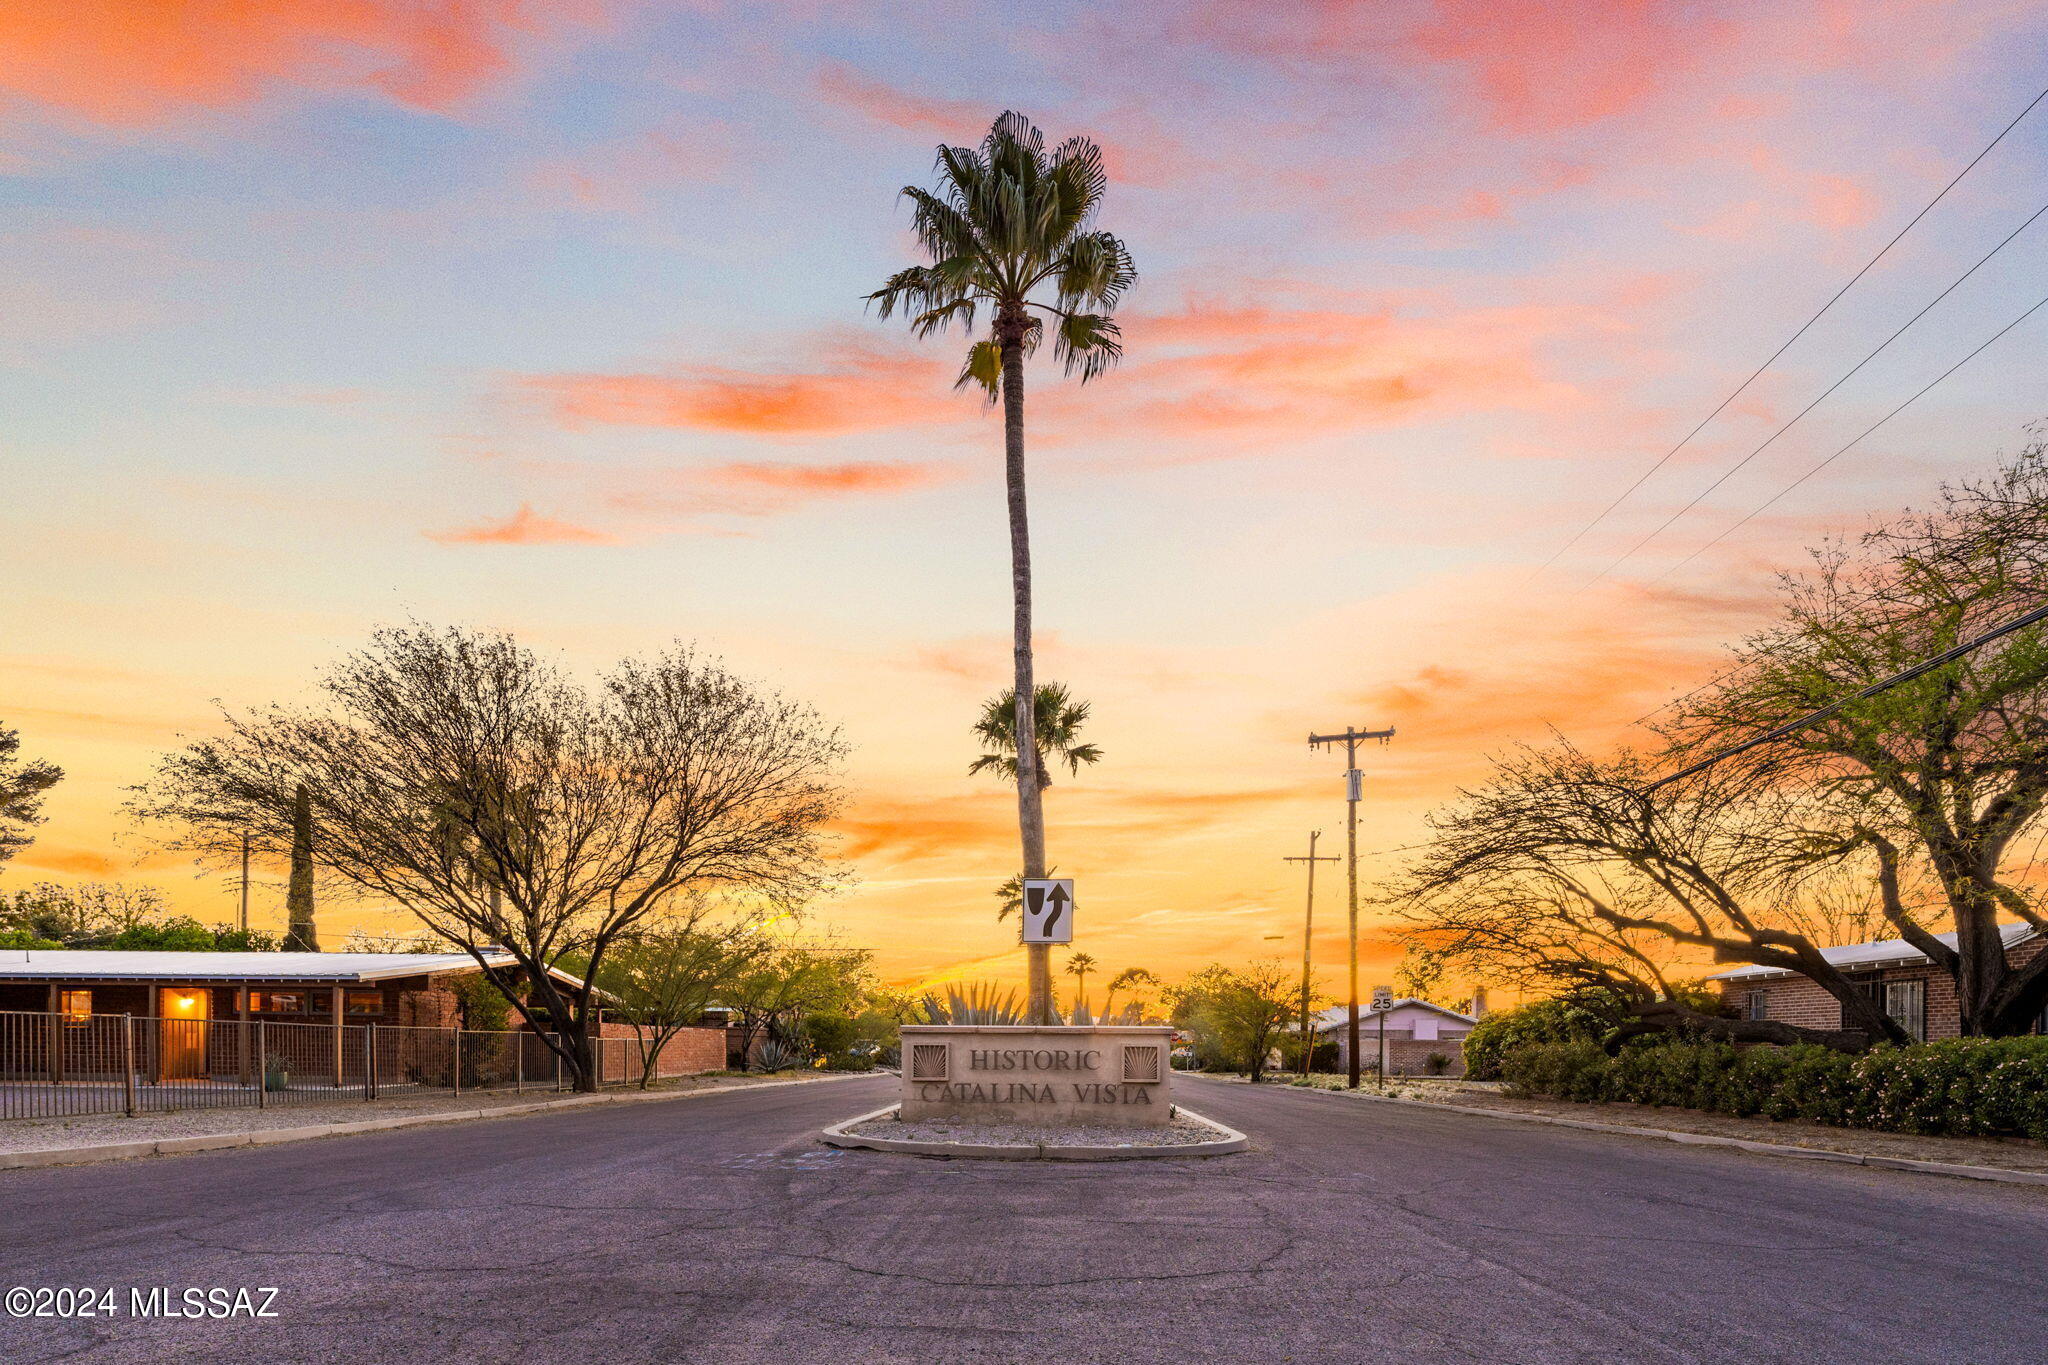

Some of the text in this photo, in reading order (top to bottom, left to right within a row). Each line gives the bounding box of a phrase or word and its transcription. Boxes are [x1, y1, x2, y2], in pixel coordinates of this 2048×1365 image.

[1373, 998, 1391, 1009] 25
[969, 1049, 1101, 1071] HISTORIC
[921, 1082, 1152, 1105] CATALINA VISTA
